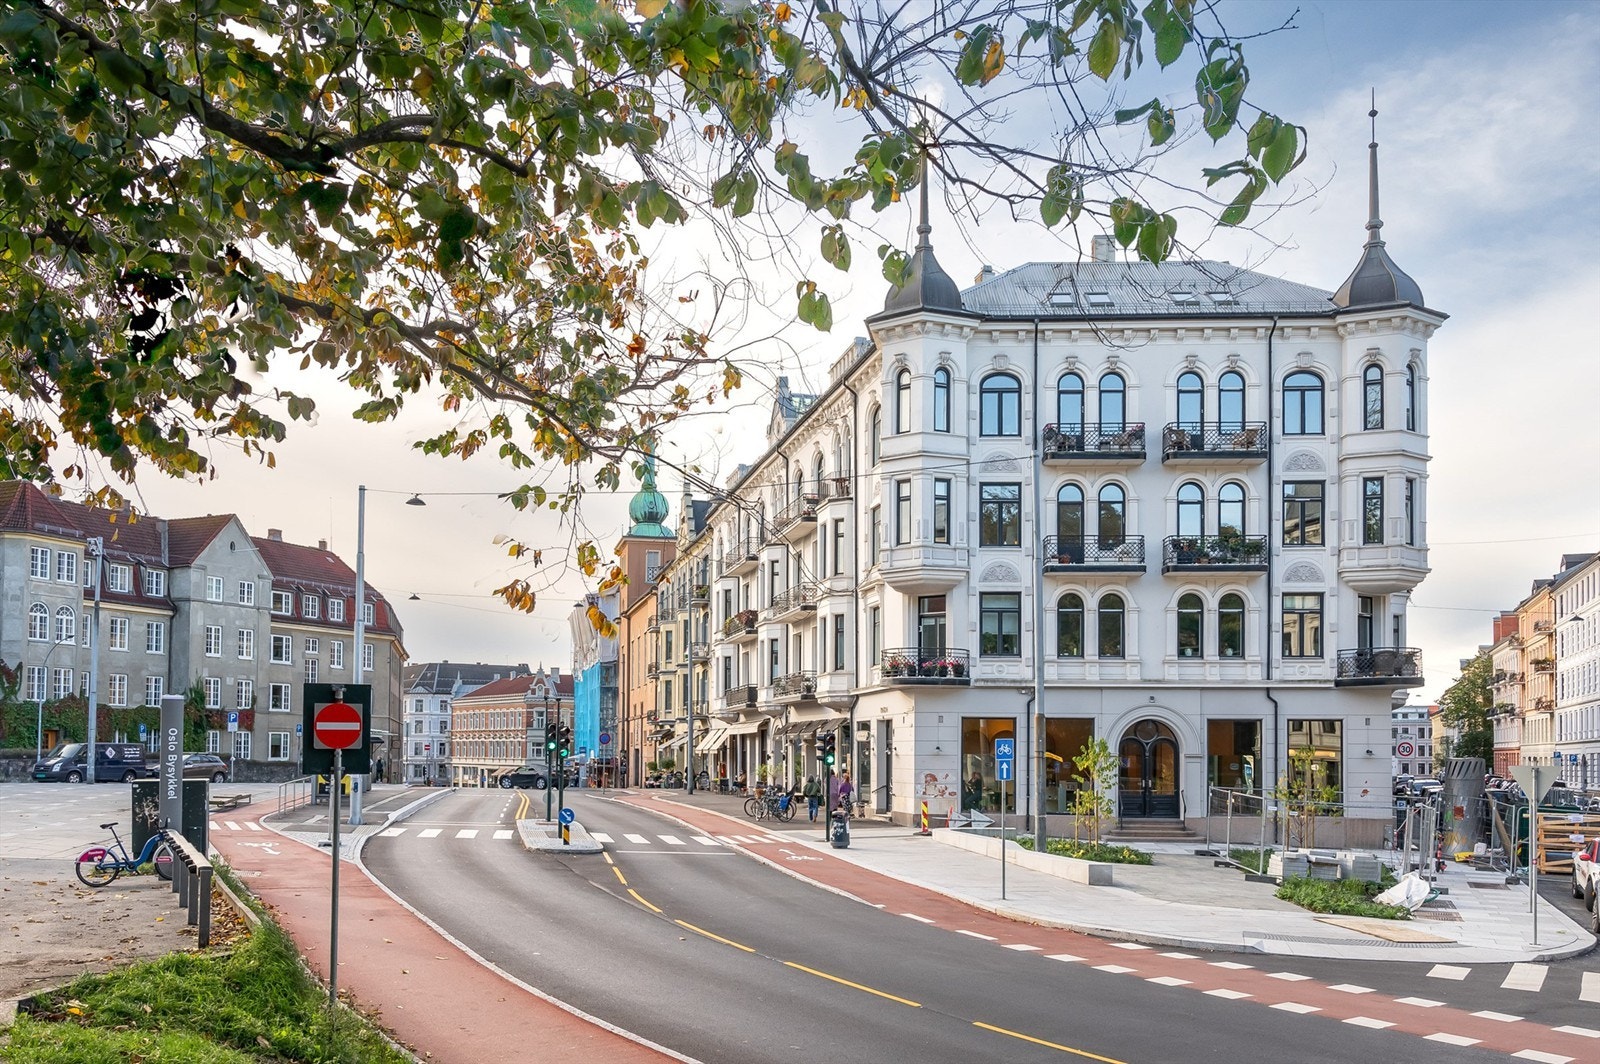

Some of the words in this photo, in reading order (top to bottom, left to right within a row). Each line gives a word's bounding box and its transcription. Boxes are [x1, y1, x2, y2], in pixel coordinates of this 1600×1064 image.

[230, 713, 236, 722] P
[168, 727, 178, 751] Oslo
[1401, 745, 1411, 753] 30
[165, 754, 178, 800] Bysykkel
